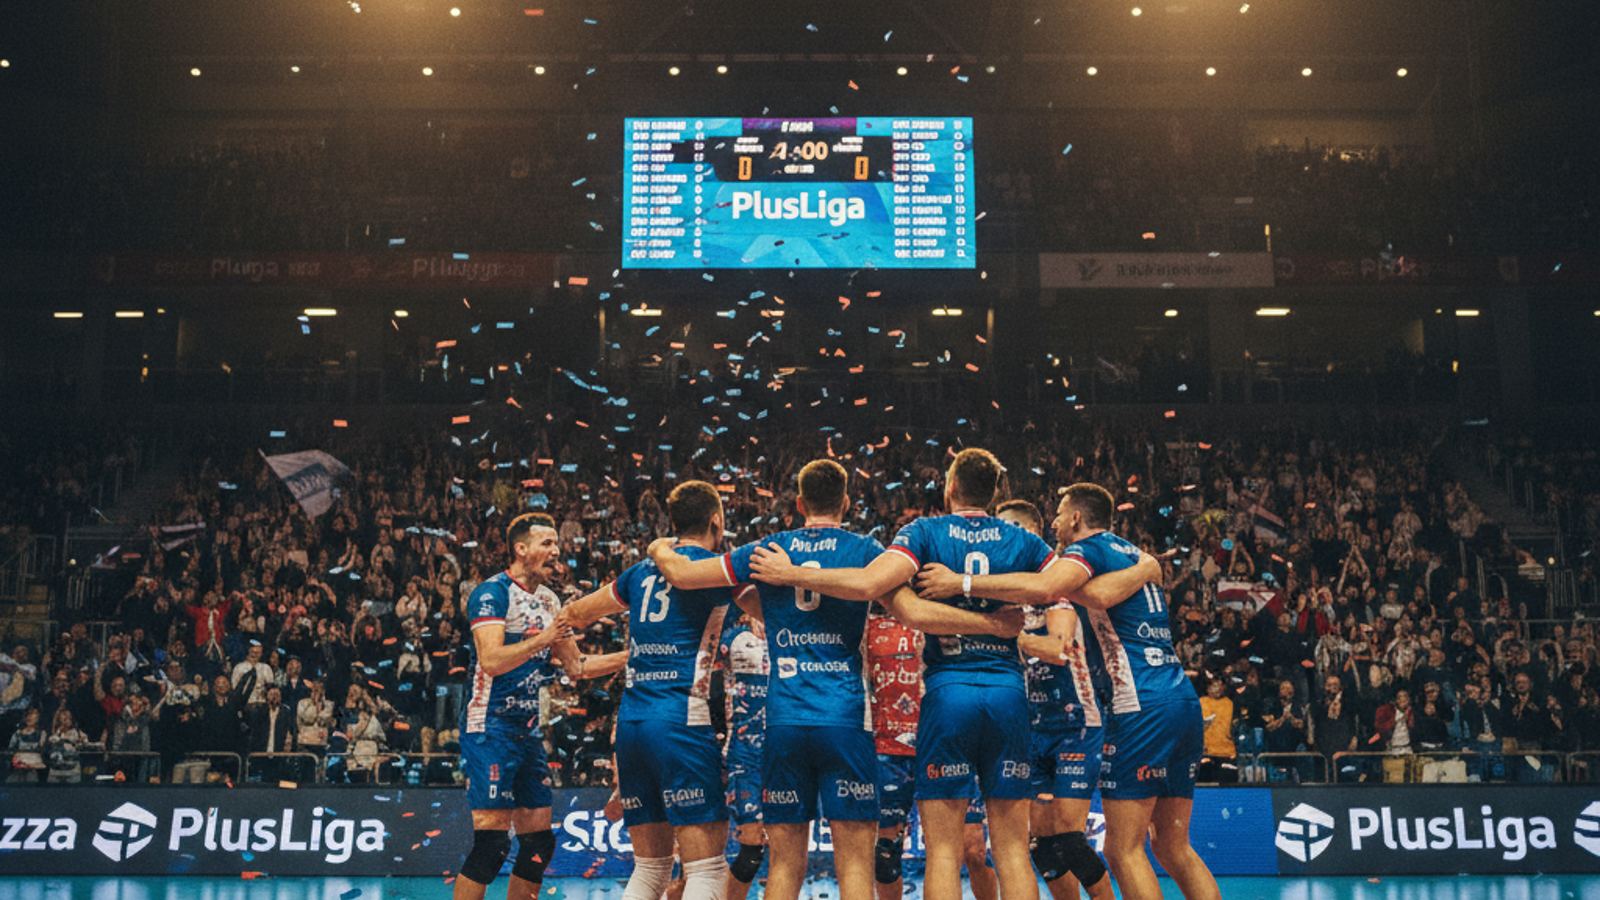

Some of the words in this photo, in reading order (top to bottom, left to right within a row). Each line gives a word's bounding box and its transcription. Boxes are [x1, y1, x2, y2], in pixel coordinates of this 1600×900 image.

[732, 190, 866, 227] PlusLiga
[639, 575, 672, 623] 13
[0, 818, 77, 850] zza
[169, 807, 386, 863] PlusLiga
[1349, 805, 1557, 861] PlusLiga
